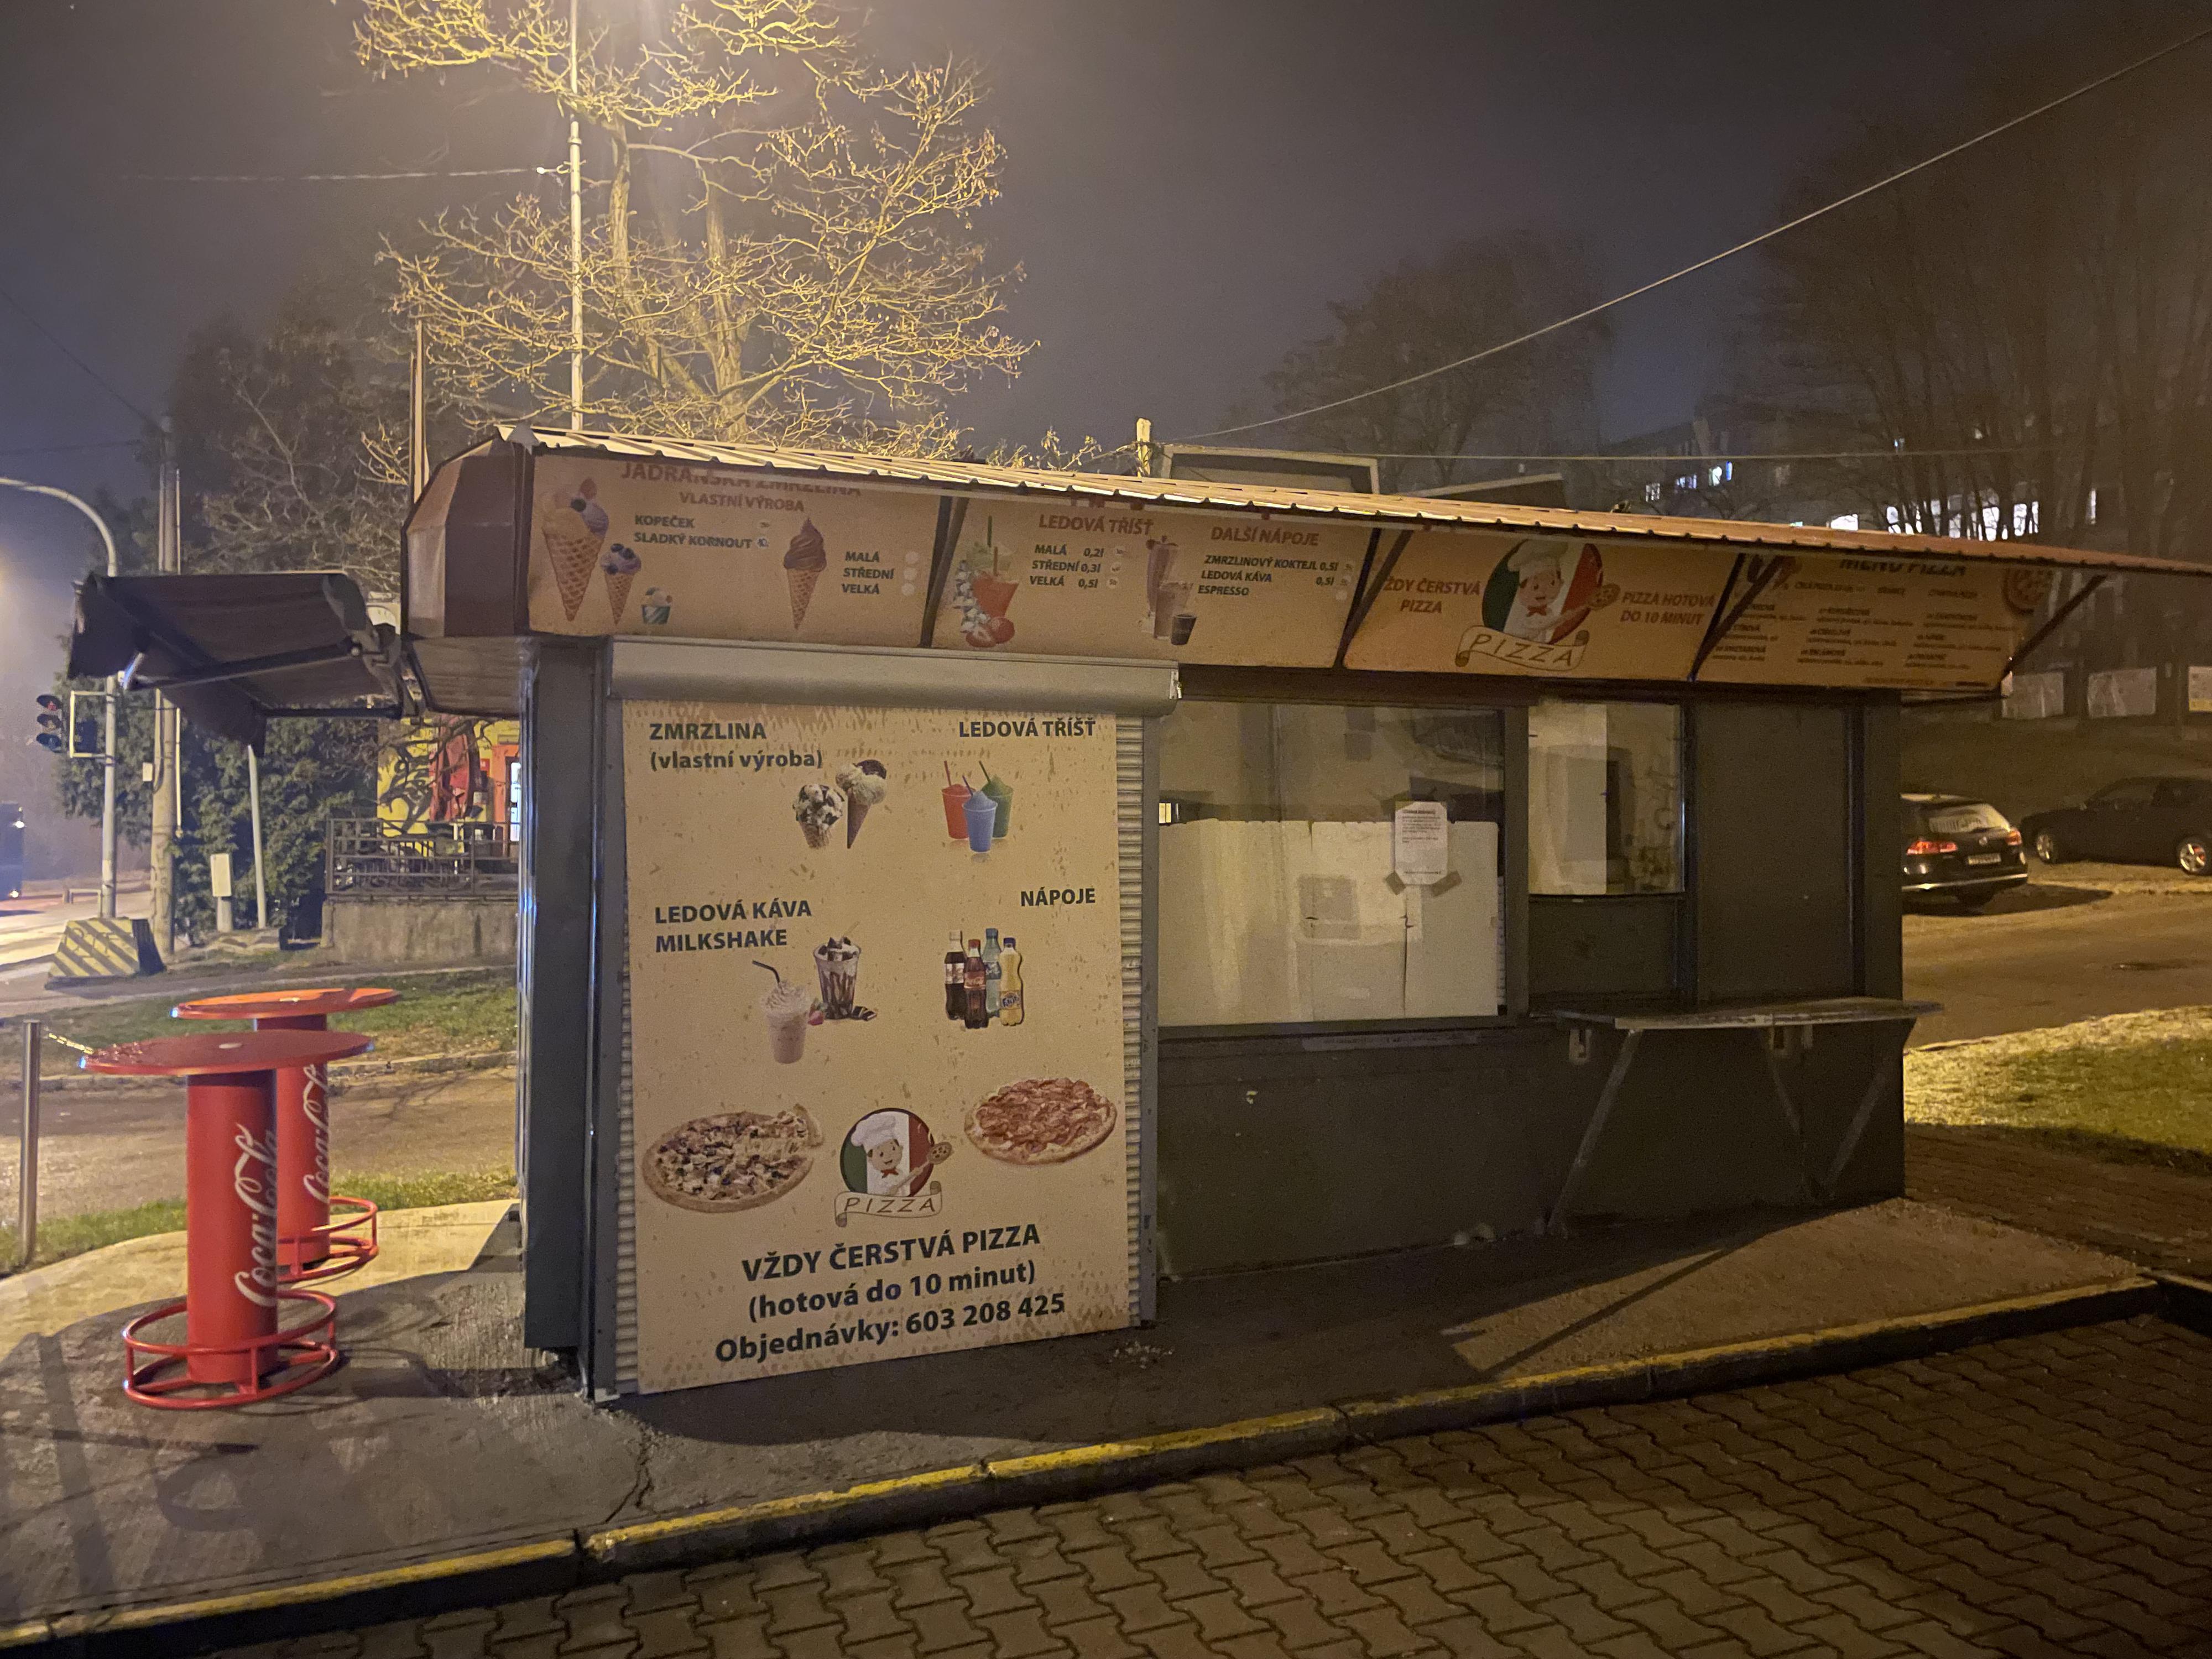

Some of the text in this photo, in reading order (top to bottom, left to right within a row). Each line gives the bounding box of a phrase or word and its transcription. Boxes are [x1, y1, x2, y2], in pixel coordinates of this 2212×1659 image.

[680, 492, 805, 513] VLASTNÍ VÝROBA
[634, 514, 695, 529] KOPEČEK
[1039, 514, 1154, 535] LEDOVÁ TŘÍŠŤ
[634, 530, 686, 545] SLADKÝ
[688, 534, 752, 549] KORNOUT
[1211, 525, 1319, 546] DALŠÍ NÁPOJE
[845, 550, 880, 564] MALÁ
[1034, 542, 1067, 556] MALÁ
[1031, 558, 1080, 572] STŘEDNÍ
[1204, 554, 1274, 568] ZMRZLINOVÝ
[1274, 559, 1318, 571] KOKTEJL
[843, 565, 895, 580] STŘEDNÍ
[1029, 573, 1065, 587] VELKÁ
[1201, 570, 1244, 581] LEDOVÁ
[1244, 571, 1273, 582] KÁVA
[842, 581, 880, 596] VELKÁ
[1197, 585, 1250, 596] ESPRESSO
[1382, 576, 1481, 596] ŽDY ČERSTVÁ
[1400, 598, 1443, 614] PIZZA
[1621, 592, 1717, 608] PIZZA HOTOVÁ
[1620, 609, 1705, 626] DO 10 MINUT
[1469, 633, 1573, 668] PIZZA
[649, 722, 768, 740] ZMRZLINA
[958, 717, 1096, 738] LEDOVÁ TŘÍŠŤ
[650, 749, 823, 772] (vlastní výroba)
[1020, 886, 1096, 907] NÁPOJE
[654, 897, 812, 924] LEDOVÁ KÁVA
[655, 929, 788, 953] MILKSHAKE
[843, 1197, 936, 1213] PIZZA
[742, 1224, 1041, 1282] VŽDY ČERSTVÁ PIZZA
[749, 1259, 1036, 1323] (hotová do 10 minut)
[715, 1292, 1065, 1363] Objednávky: 603 208 425
